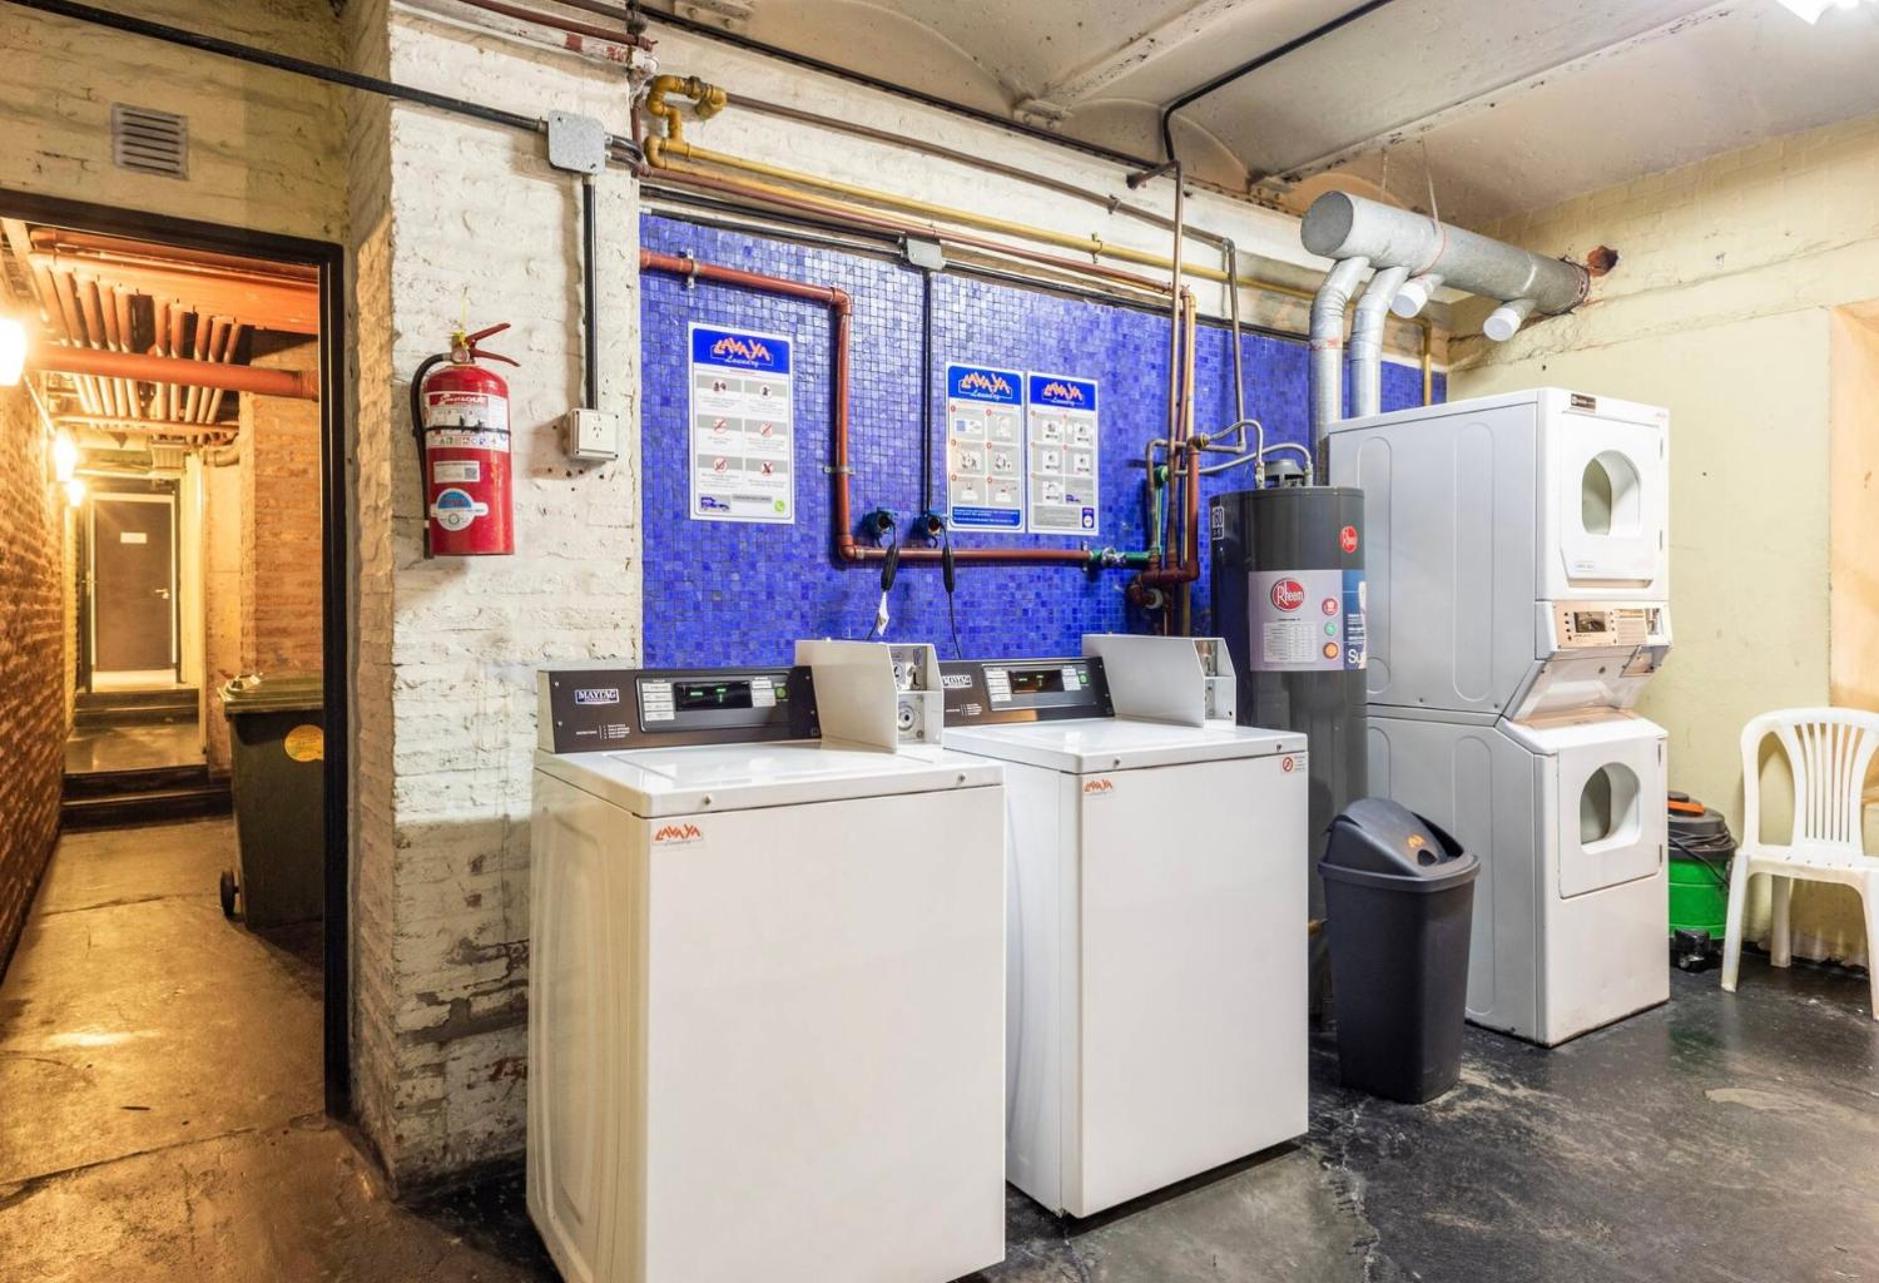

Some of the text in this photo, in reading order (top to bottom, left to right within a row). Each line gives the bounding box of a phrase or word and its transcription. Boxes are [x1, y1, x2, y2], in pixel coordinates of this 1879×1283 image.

[714, 337, 770, 361] LAVAYA
[961, 371, 1010, 394] LAVAYA
[1277, 582, 1304, 606] Rheem
[578, 690, 616, 700] MAYTAG
[655, 823, 701, 841] LAVAYA
